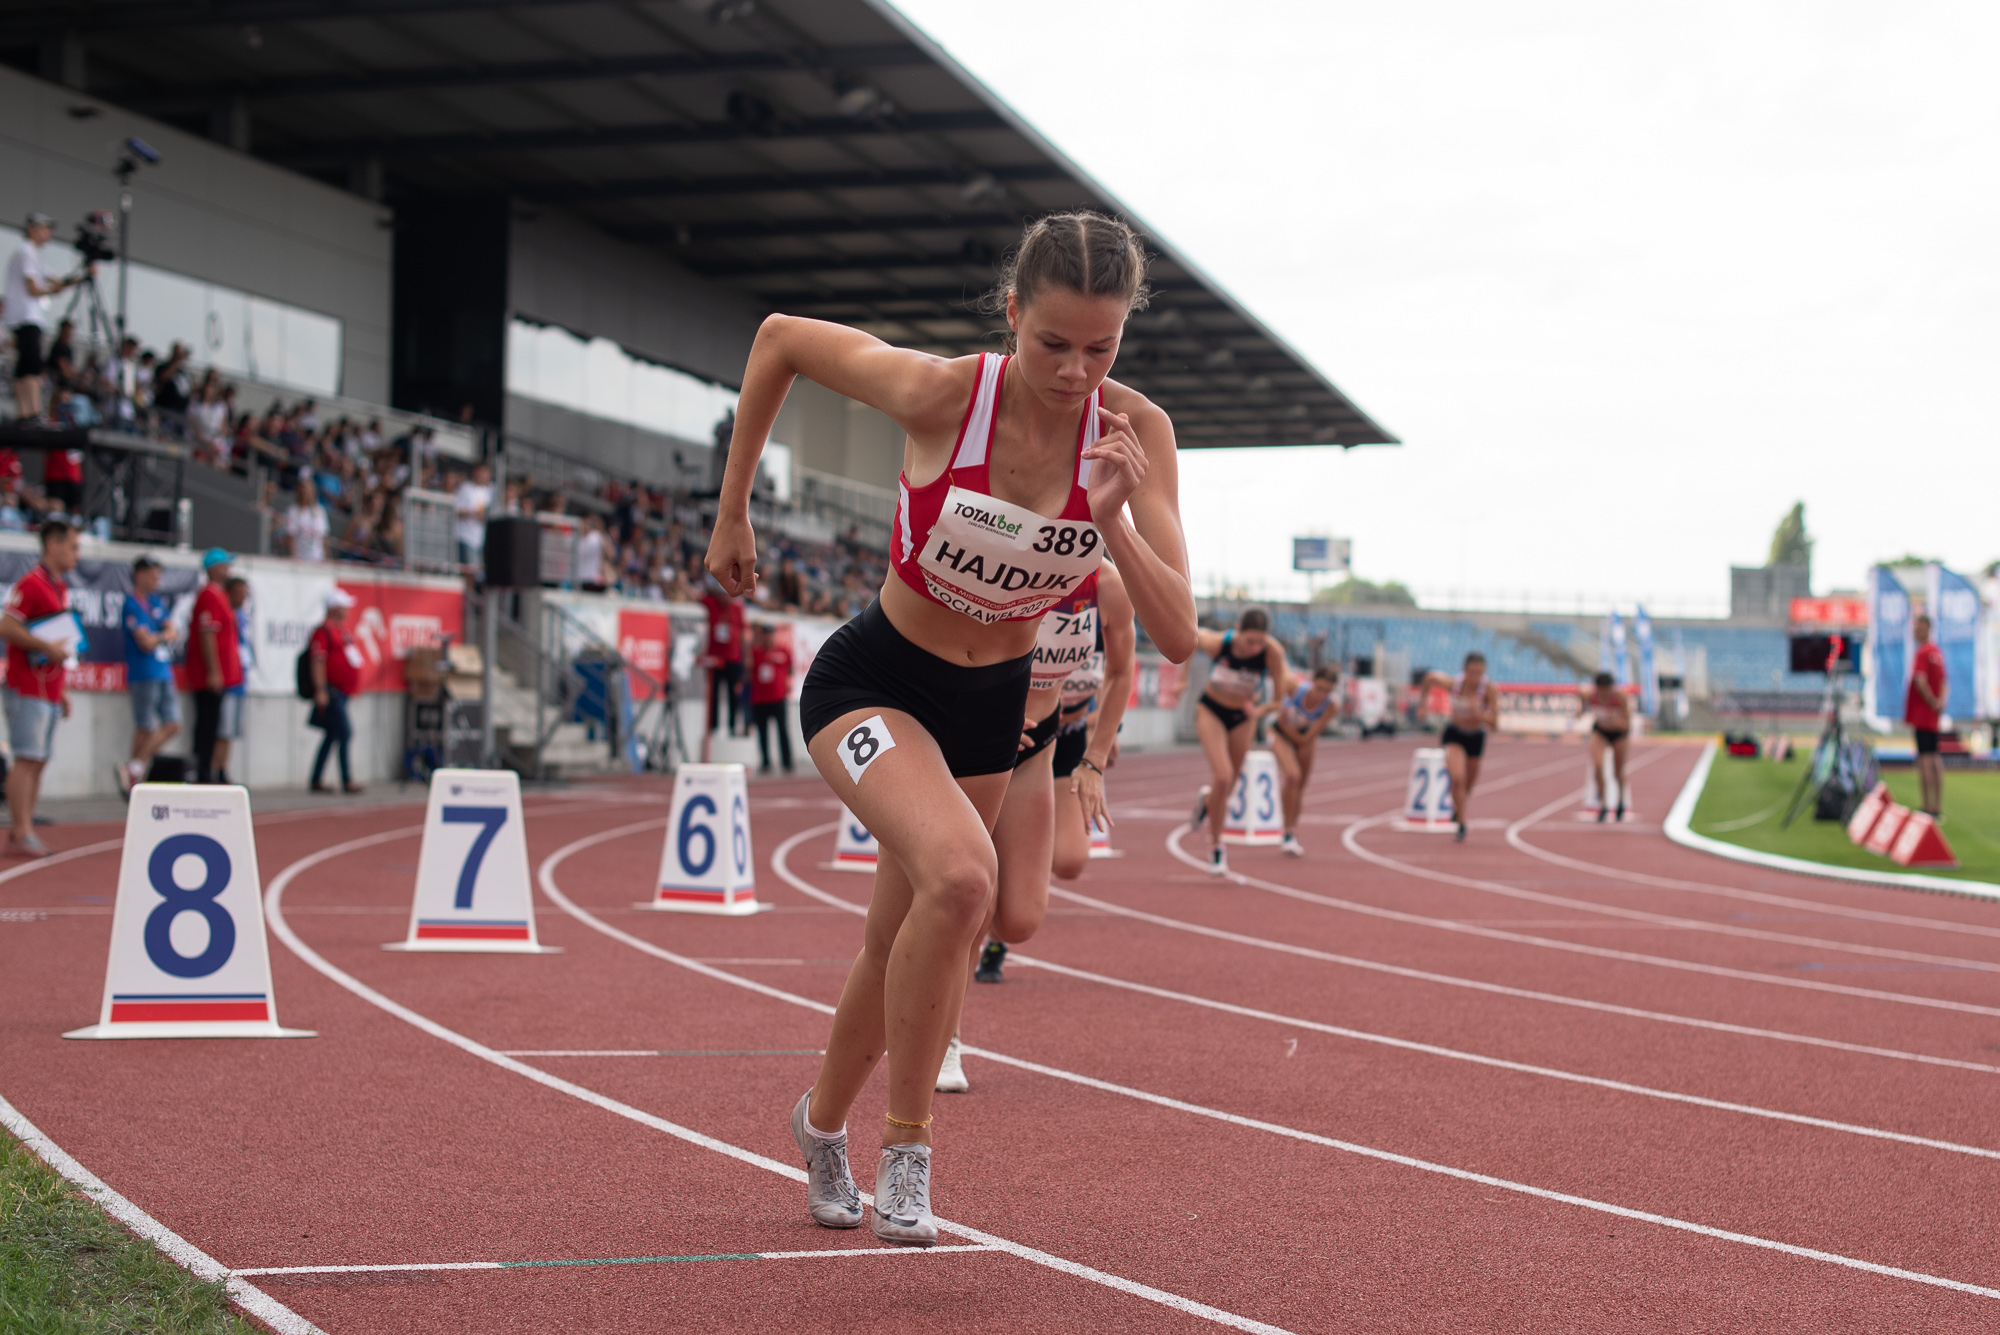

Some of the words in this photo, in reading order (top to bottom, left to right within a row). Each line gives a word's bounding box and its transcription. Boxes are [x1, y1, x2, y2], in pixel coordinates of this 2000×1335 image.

[954, 502, 1023, 535] TOTALbet
[1033, 525, 1098, 558] 389
[935, 540, 1080, 592] HAJDUK
[935, 577, 957, 593] PZLA
[1055, 613, 1092, 635] 714
[847, 726, 879, 766] 8
[1230, 772, 1248, 821] 3
[1257, 772, 1274, 821] 3
[1412, 768, 1430, 811] 2
[1437, 768, 1452, 811] 2
[441, 805, 508, 910] 7
[677, 794, 717, 877] 6
[732, 794, 747, 877] 6
[144, 832, 236, 980] 8
